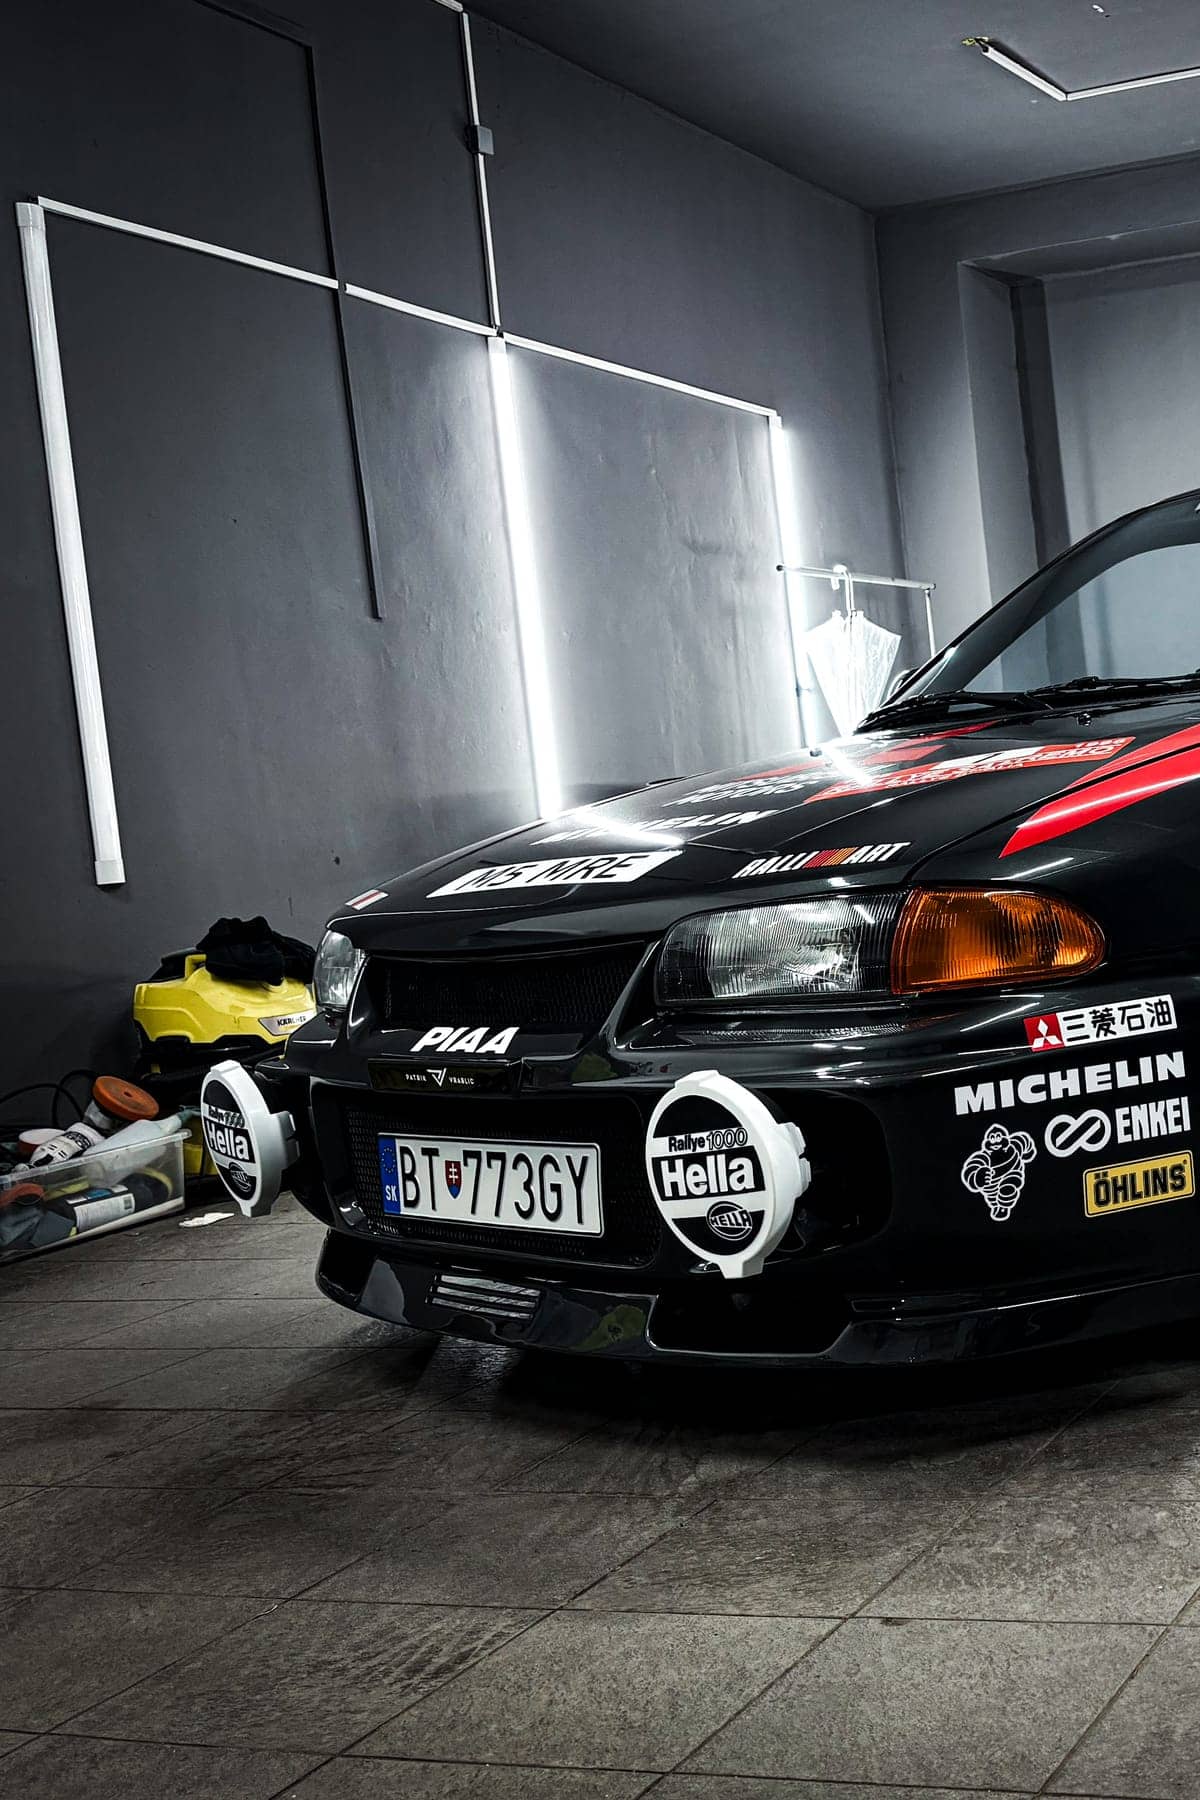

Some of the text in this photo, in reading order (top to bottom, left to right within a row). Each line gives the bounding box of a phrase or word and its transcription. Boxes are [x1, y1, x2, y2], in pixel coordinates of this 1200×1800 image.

[529, 809, 779, 846] MIHELIN
[525, 855, 651, 884] MRE
[731, 842, 912, 879] RALLI ART
[409, 1026, 520, 1054] PIAA
[1061, 998, 1175, 1043] 三菱石油
[954, 1051, 1186, 1115] MICHELIN
[668, 1127, 748, 1152] Rallye 1000
[1115, 1096, 1191, 1144] ENKEI
[205, 1119, 250, 1161] Hella
[385, 1184, 398, 1202] SK
[399, 1145, 589, 1225] BT 773GY
[660, 1153, 755, 1197] Hella
[1093, 1162, 1187, 1208] ÖHLINS
[710, 1209, 752, 1227] HELLA
